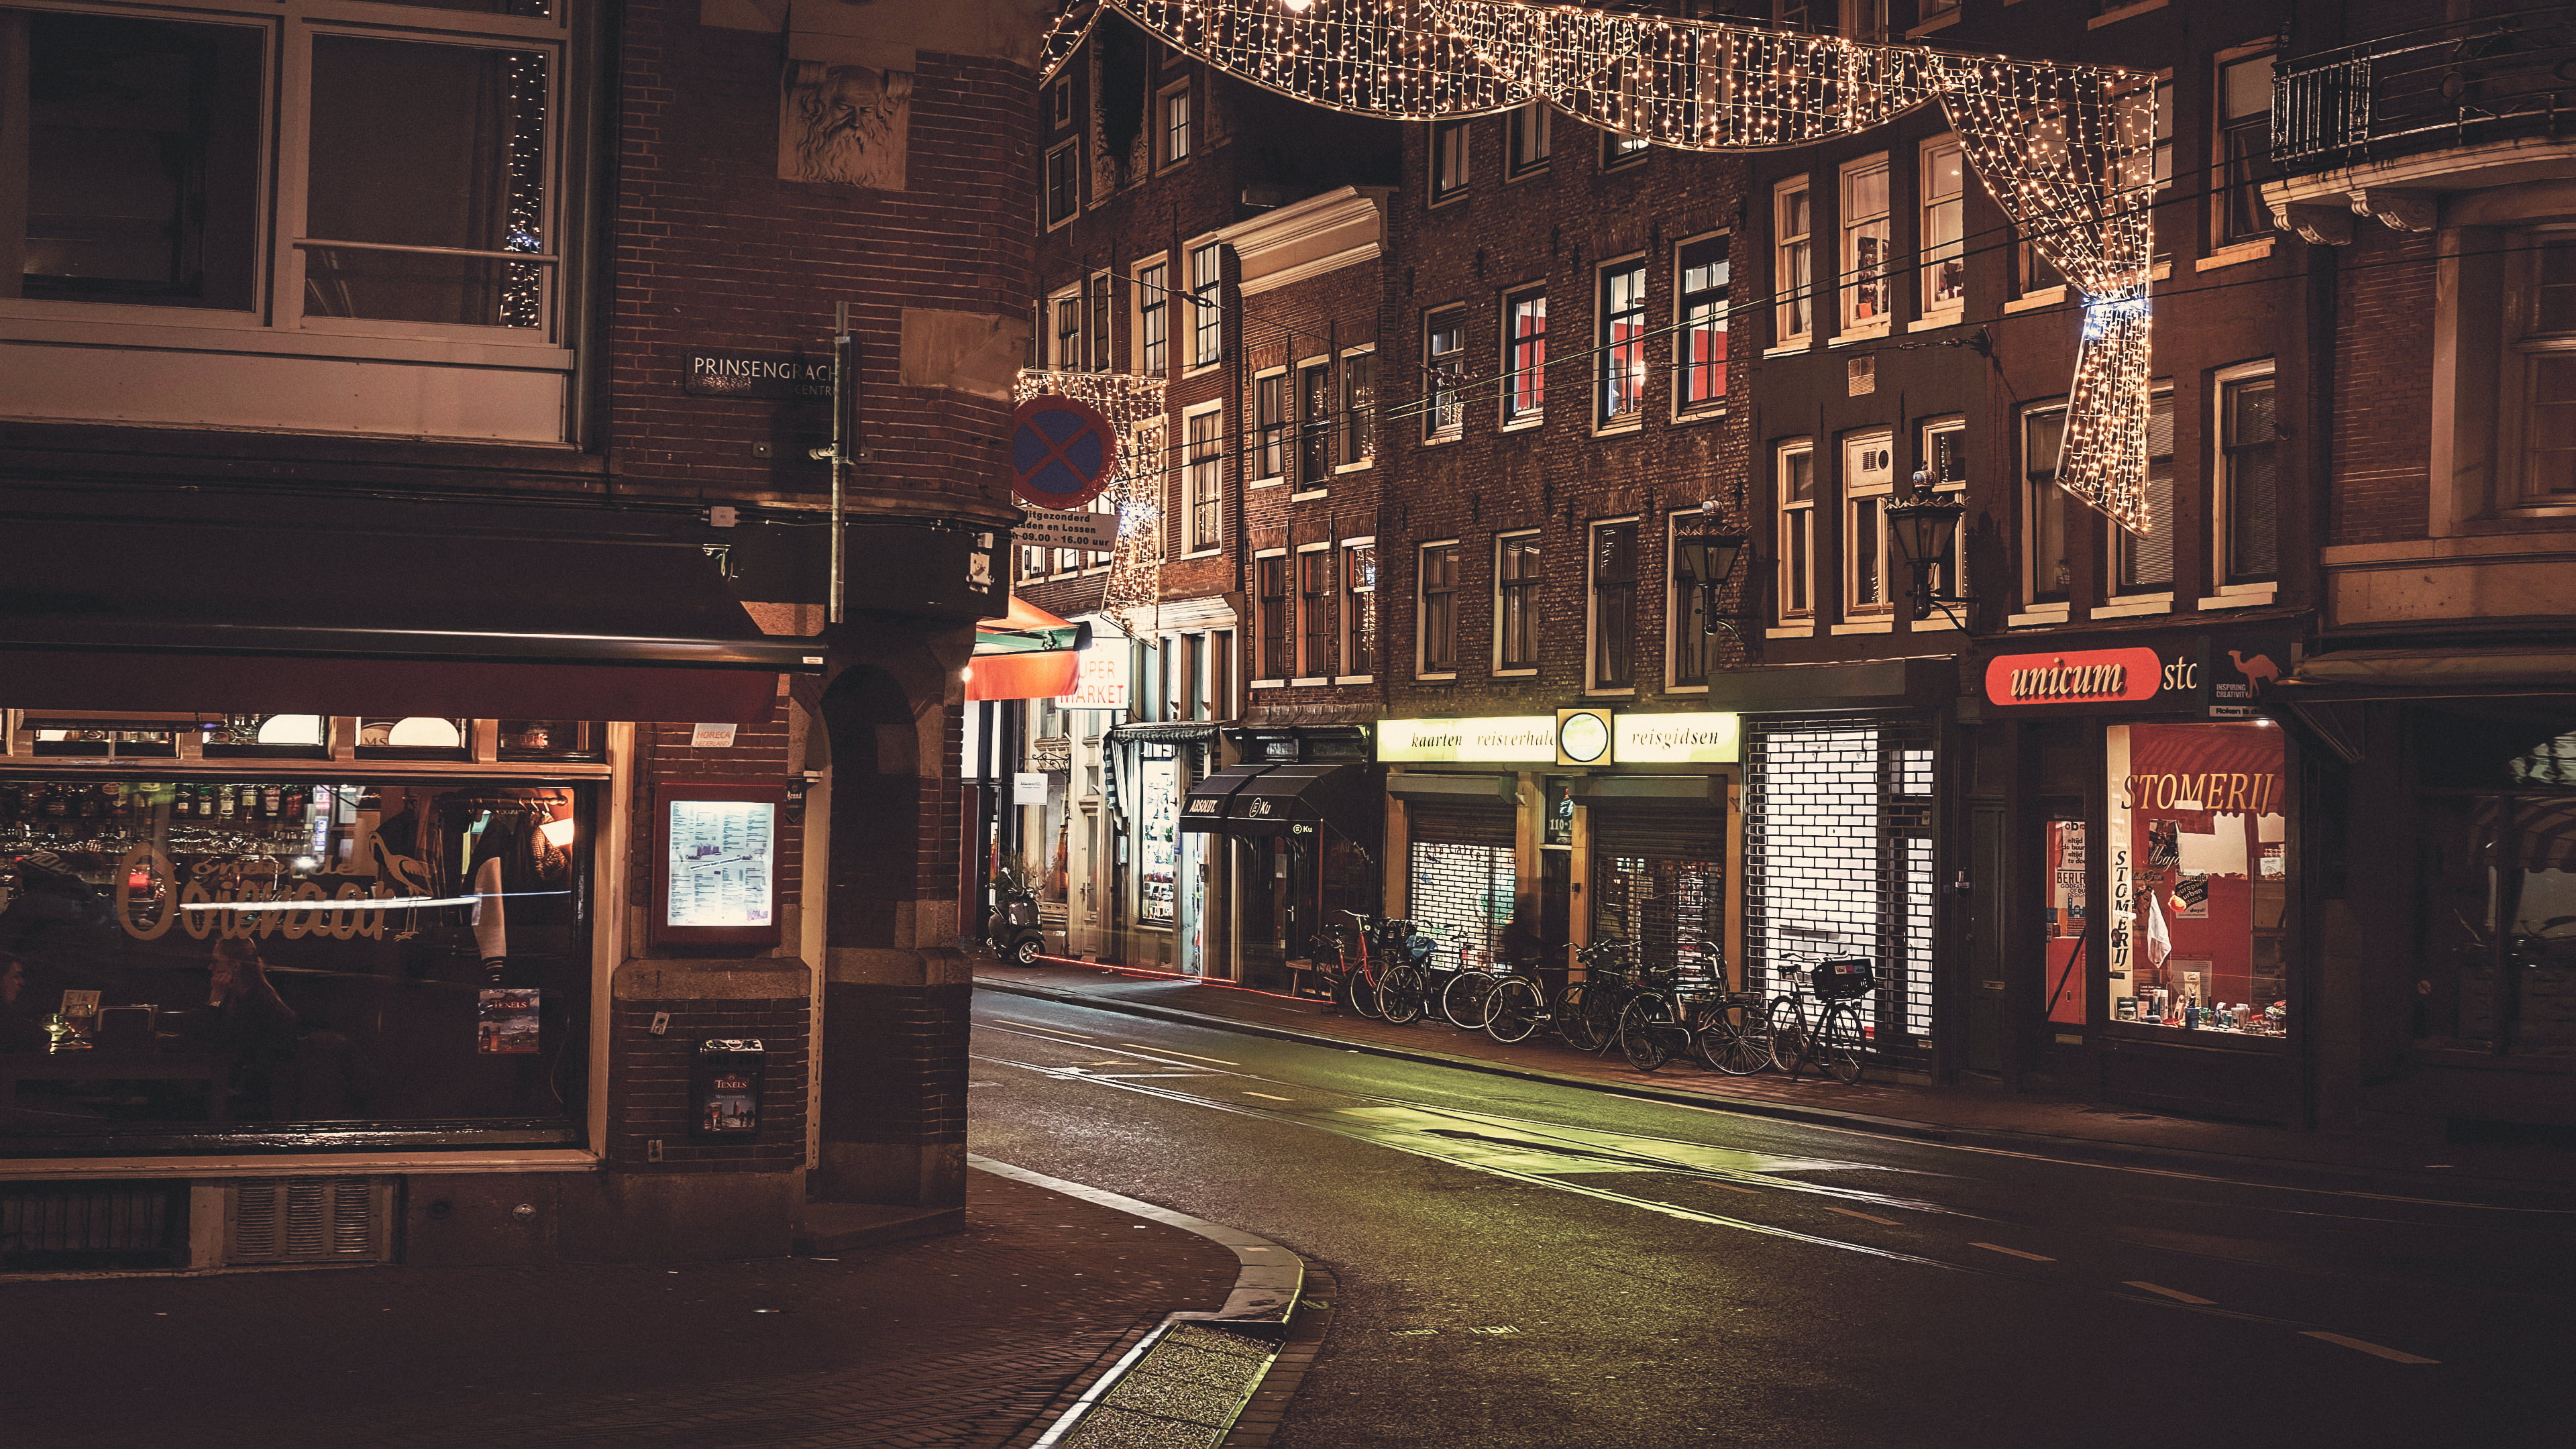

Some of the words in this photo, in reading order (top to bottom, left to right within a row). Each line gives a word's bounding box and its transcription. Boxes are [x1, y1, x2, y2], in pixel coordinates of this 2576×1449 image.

[695, 357, 836, 381] PRINSENGRACH
[794, 384, 836, 396] CENTR
[1026, 511, 1090, 523] itgezonderd
[1017, 521, 1044, 530] aden
[1062, 523, 1096, 534] Lossen
[1022, 533, 1051, 542] 09.00
[1061, 535, 1089, 545] 16.00
[1092, 539, 1110, 547] uur
[1079, 661, 1115, 679] UPER
[2010, 657, 2123, 697] unicum
[1411, 730, 1462, 747] kaarten
[1631, 727, 1719, 750] reisgidsen
[2121, 773, 2275, 816] STOMERIJ
[1258, 801, 1271, 814] Ku
[1550, 818, 1572, 830] 110-1
[2057, 872, 2086, 883] BERLA
[492, 1000, 527, 1008] TEXELS
[714, 1079, 747, 1088] TEXELS
